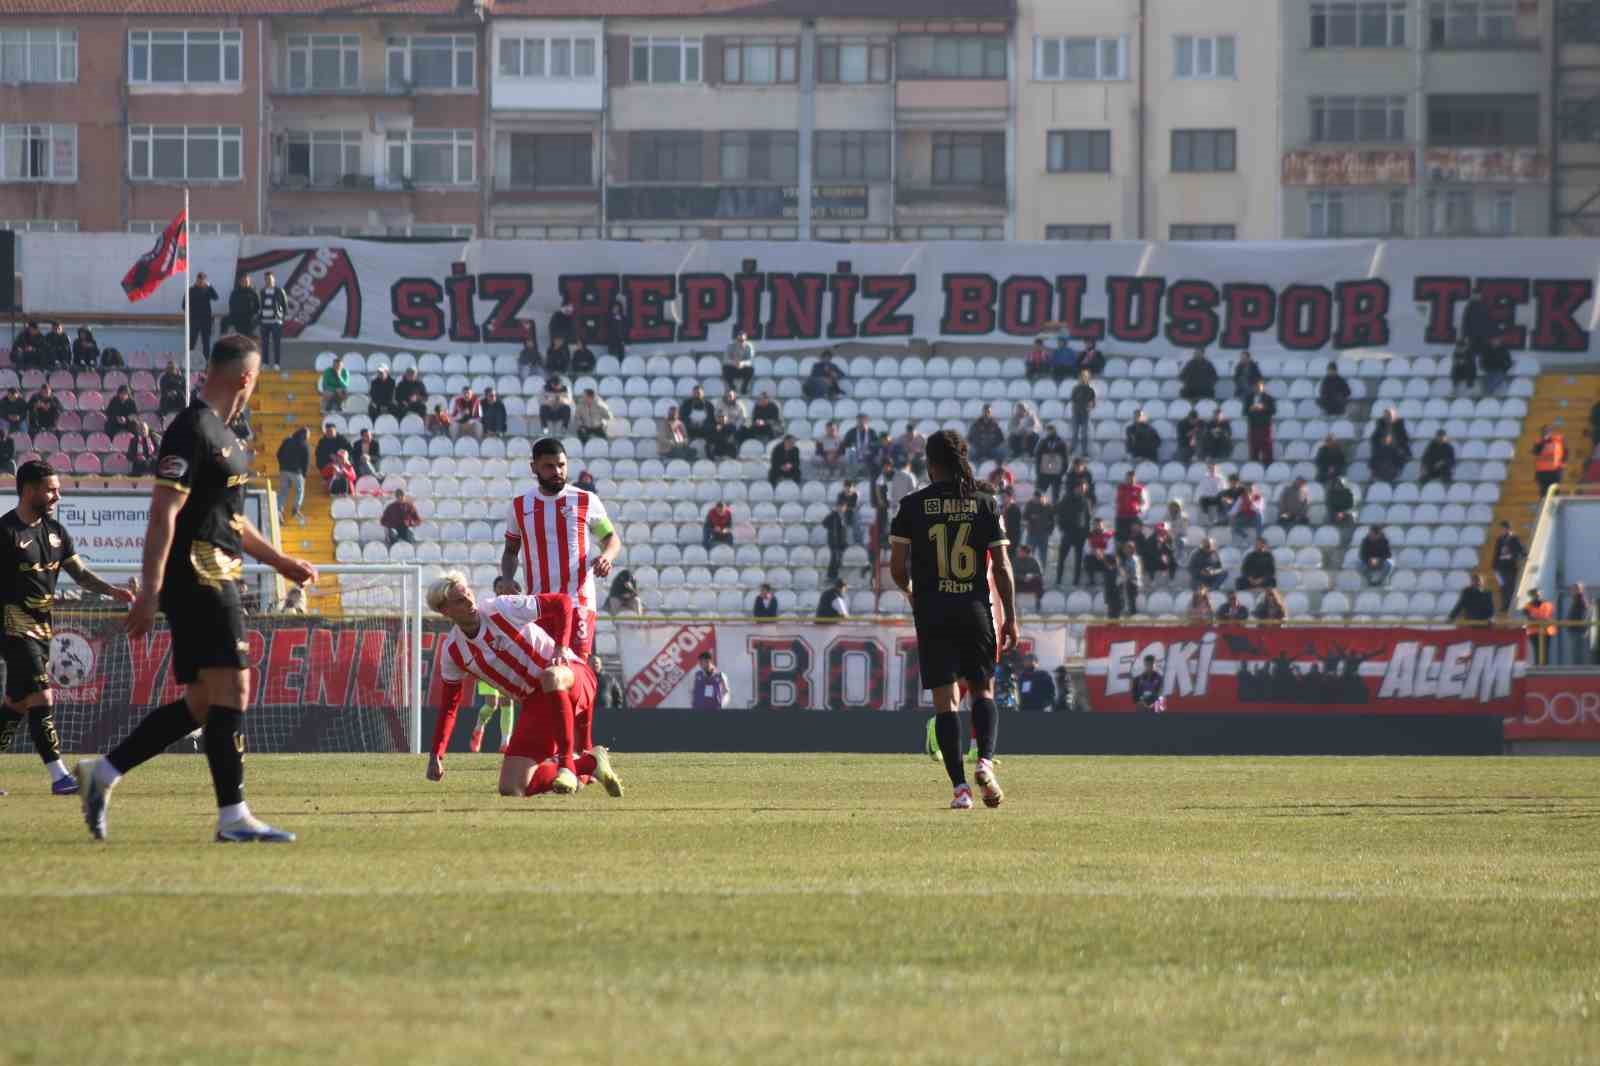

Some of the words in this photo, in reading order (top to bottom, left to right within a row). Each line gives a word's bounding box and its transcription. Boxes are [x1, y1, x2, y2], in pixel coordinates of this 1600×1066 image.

[390, 261, 532, 343] SİZ
[559, 258, 917, 344] HEPİNİZ
[941, 272, 1390, 352] BOLUSPOR
[928, 521, 977, 579] 16
[577, 620, 589, 640] 3
[1377, 640, 1519, 703] ALEM
